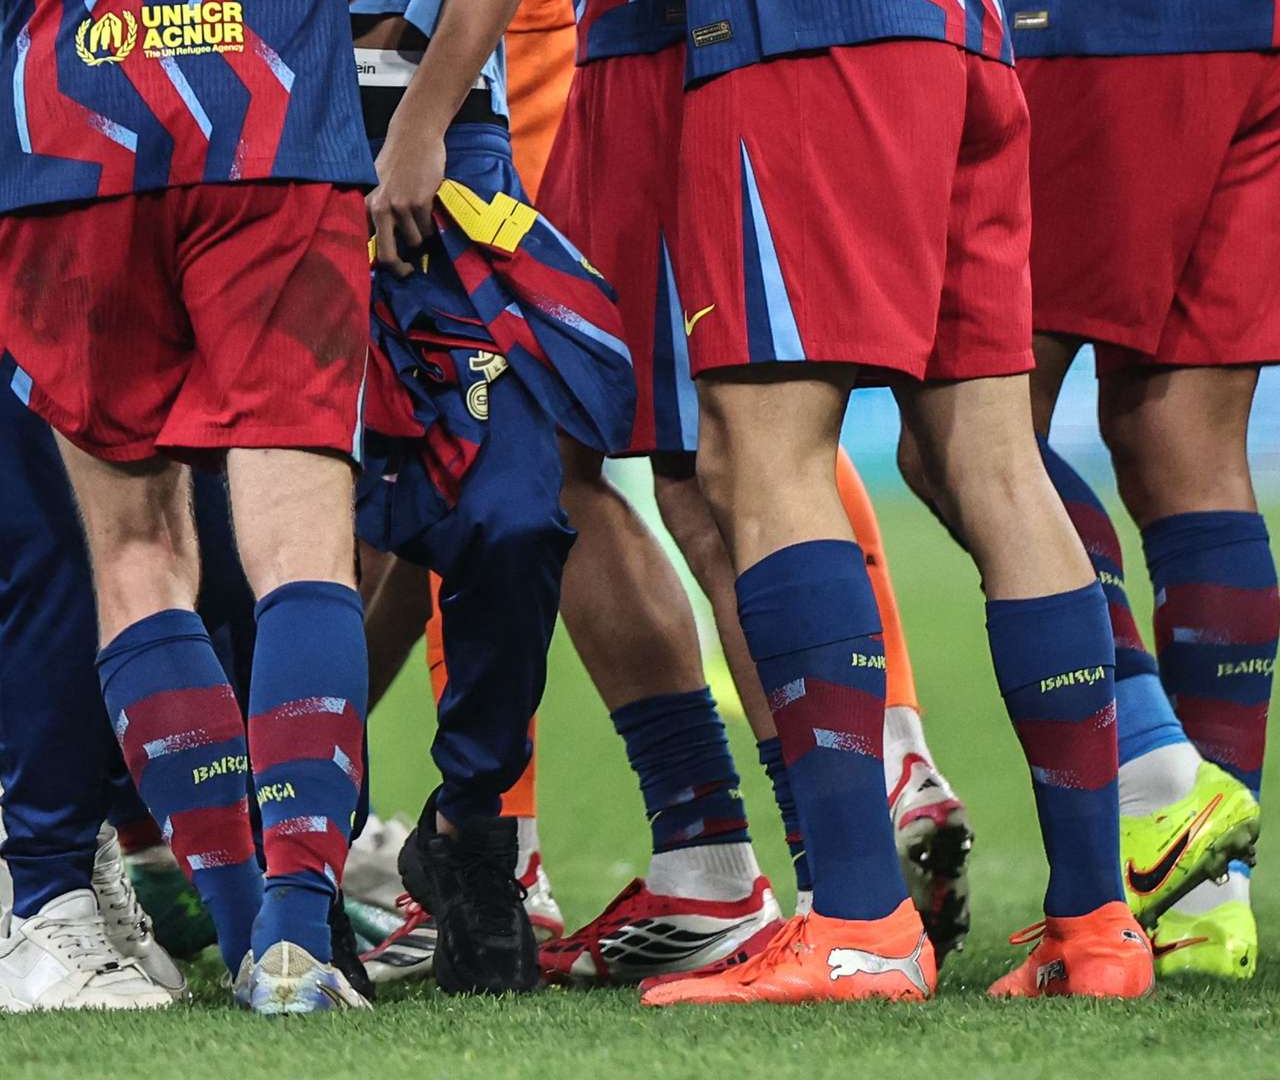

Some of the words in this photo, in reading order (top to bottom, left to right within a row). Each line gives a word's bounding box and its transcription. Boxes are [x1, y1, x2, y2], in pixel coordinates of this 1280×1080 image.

[141, 1, 244, 28] UNHCR
[142, 23, 244, 50] ACNUR
[144, 50, 161, 59] The
[161, 47, 176, 57] UN
[176, 45, 211, 56] Refugee
[212, 43, 244, 54] Agency
[356, 62, 376, 75] ein
